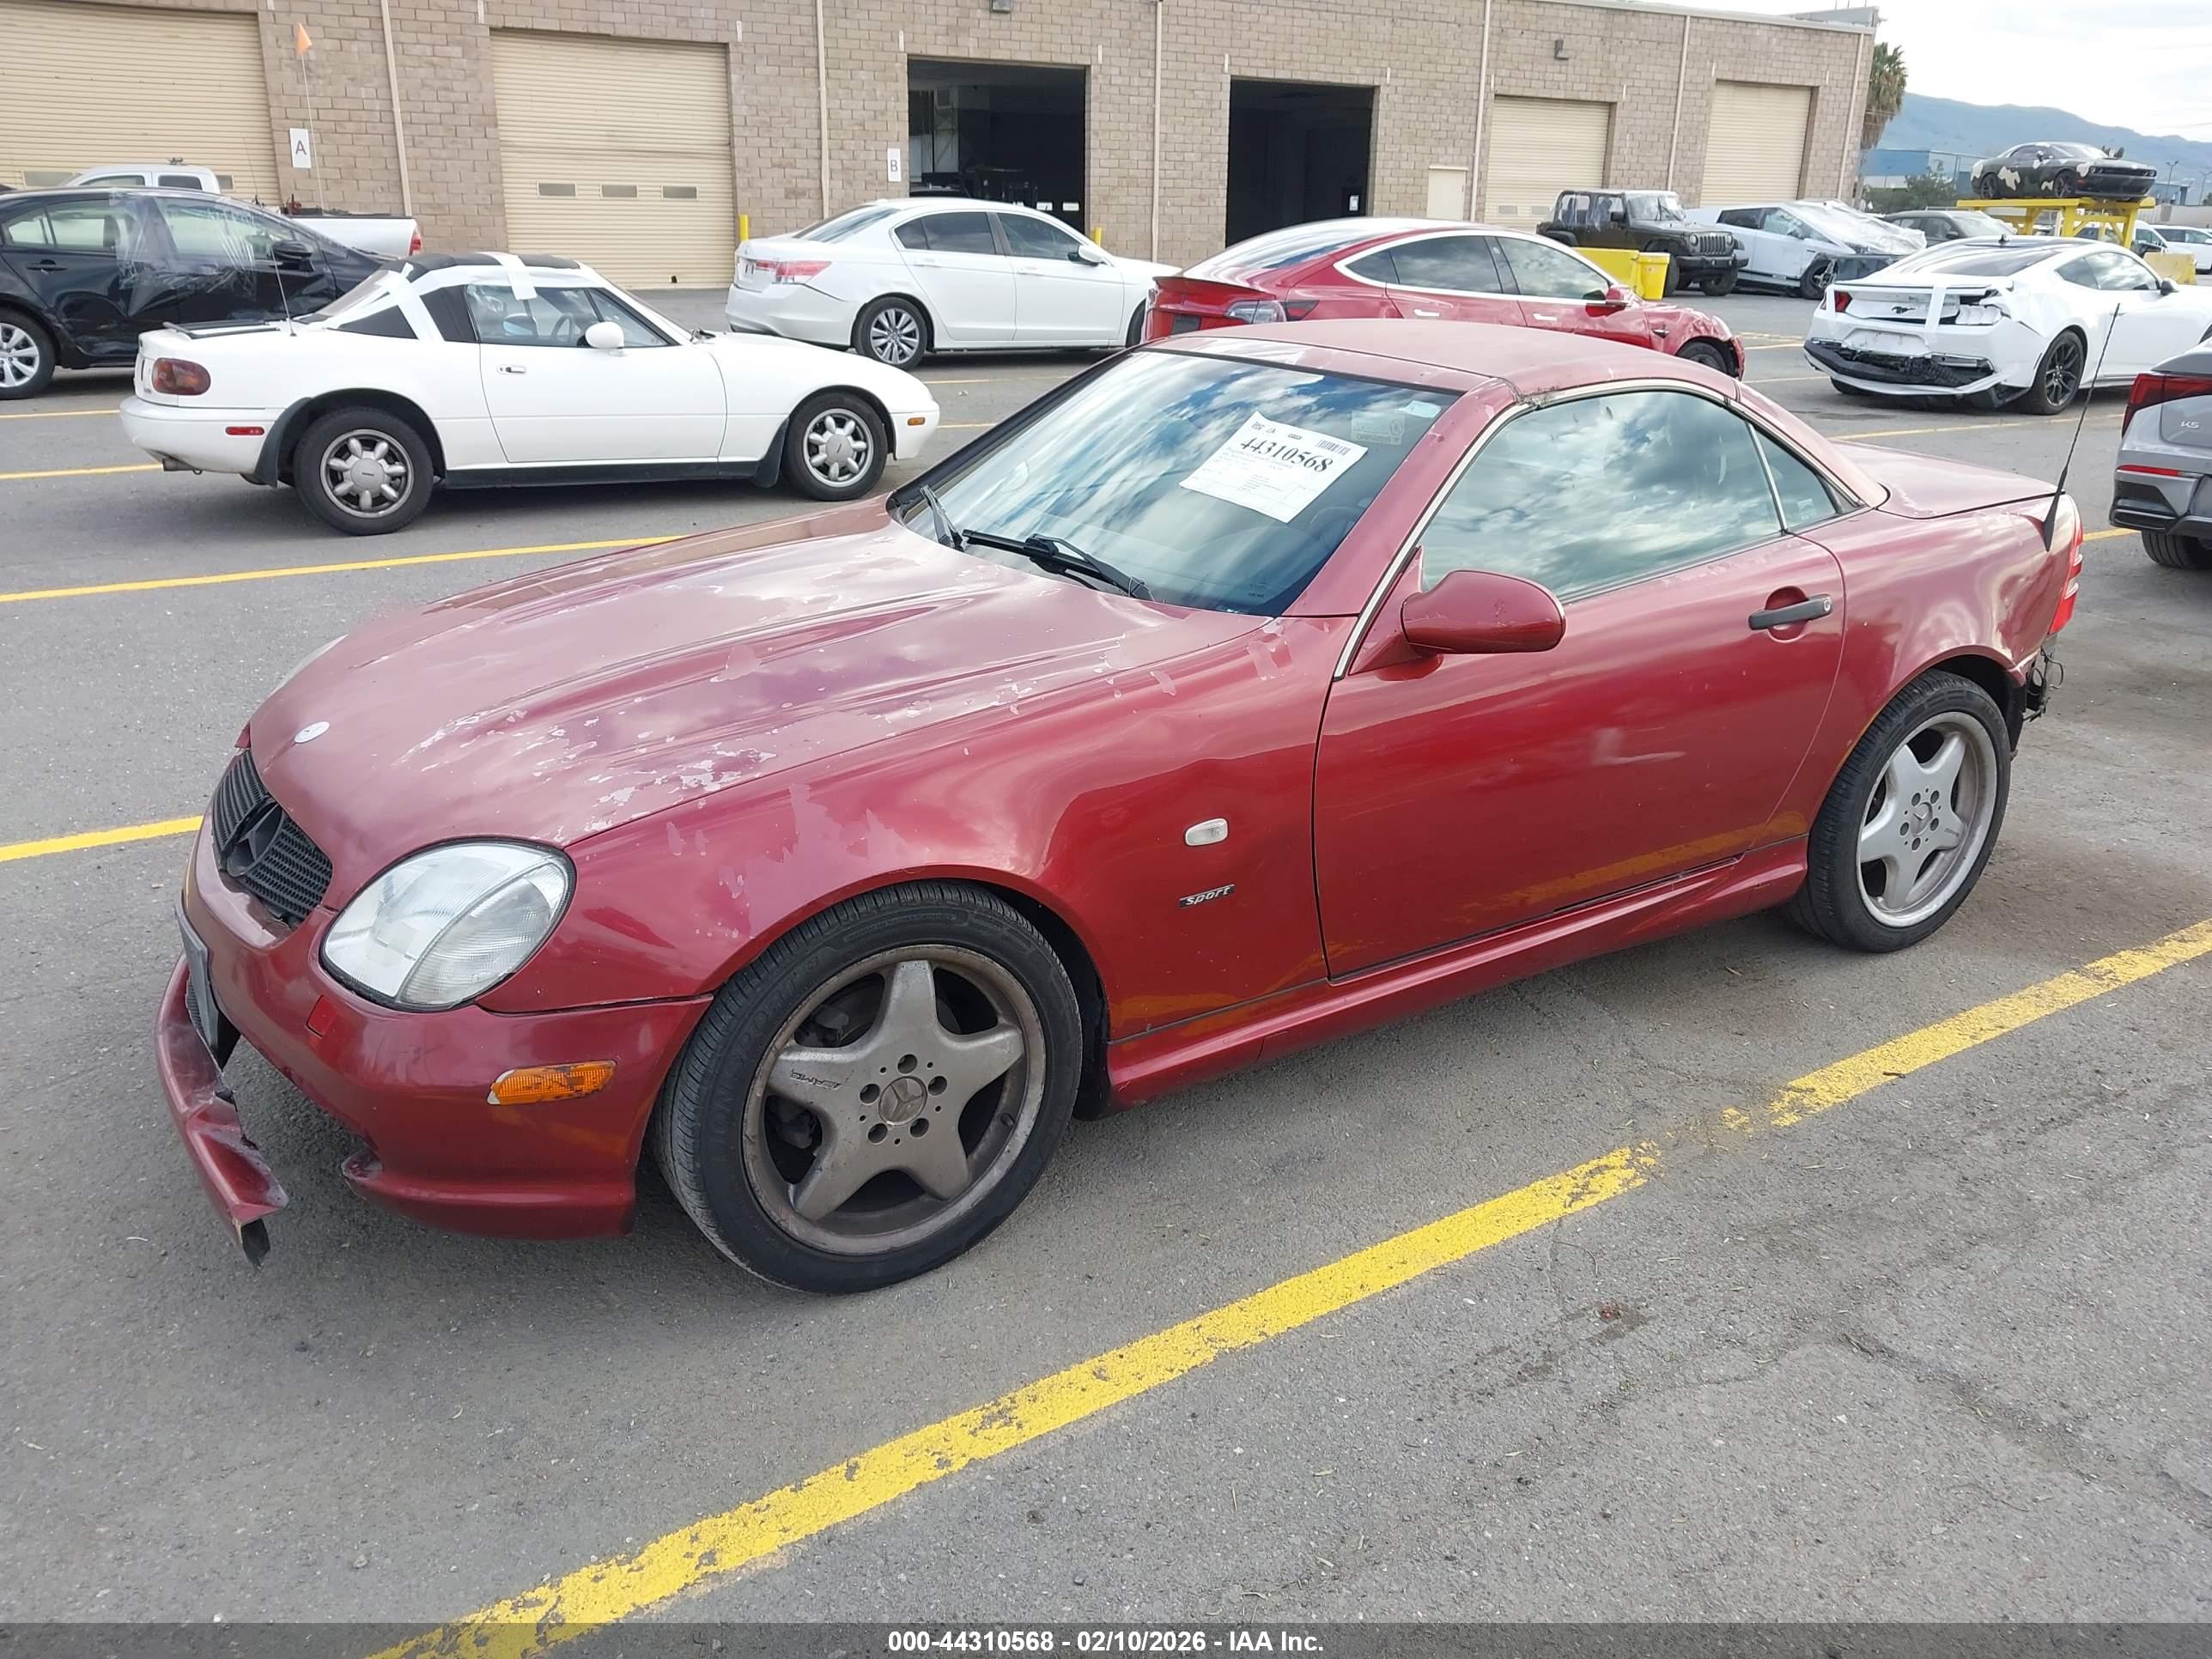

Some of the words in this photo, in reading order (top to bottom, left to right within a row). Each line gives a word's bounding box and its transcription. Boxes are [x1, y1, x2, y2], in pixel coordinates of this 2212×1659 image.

[295, 140, 307, 155] A
[890, 159, 898, 173] B
[1240, 437, 1334, 472] 44310568
[1186, 886, 1231, 905] sport
